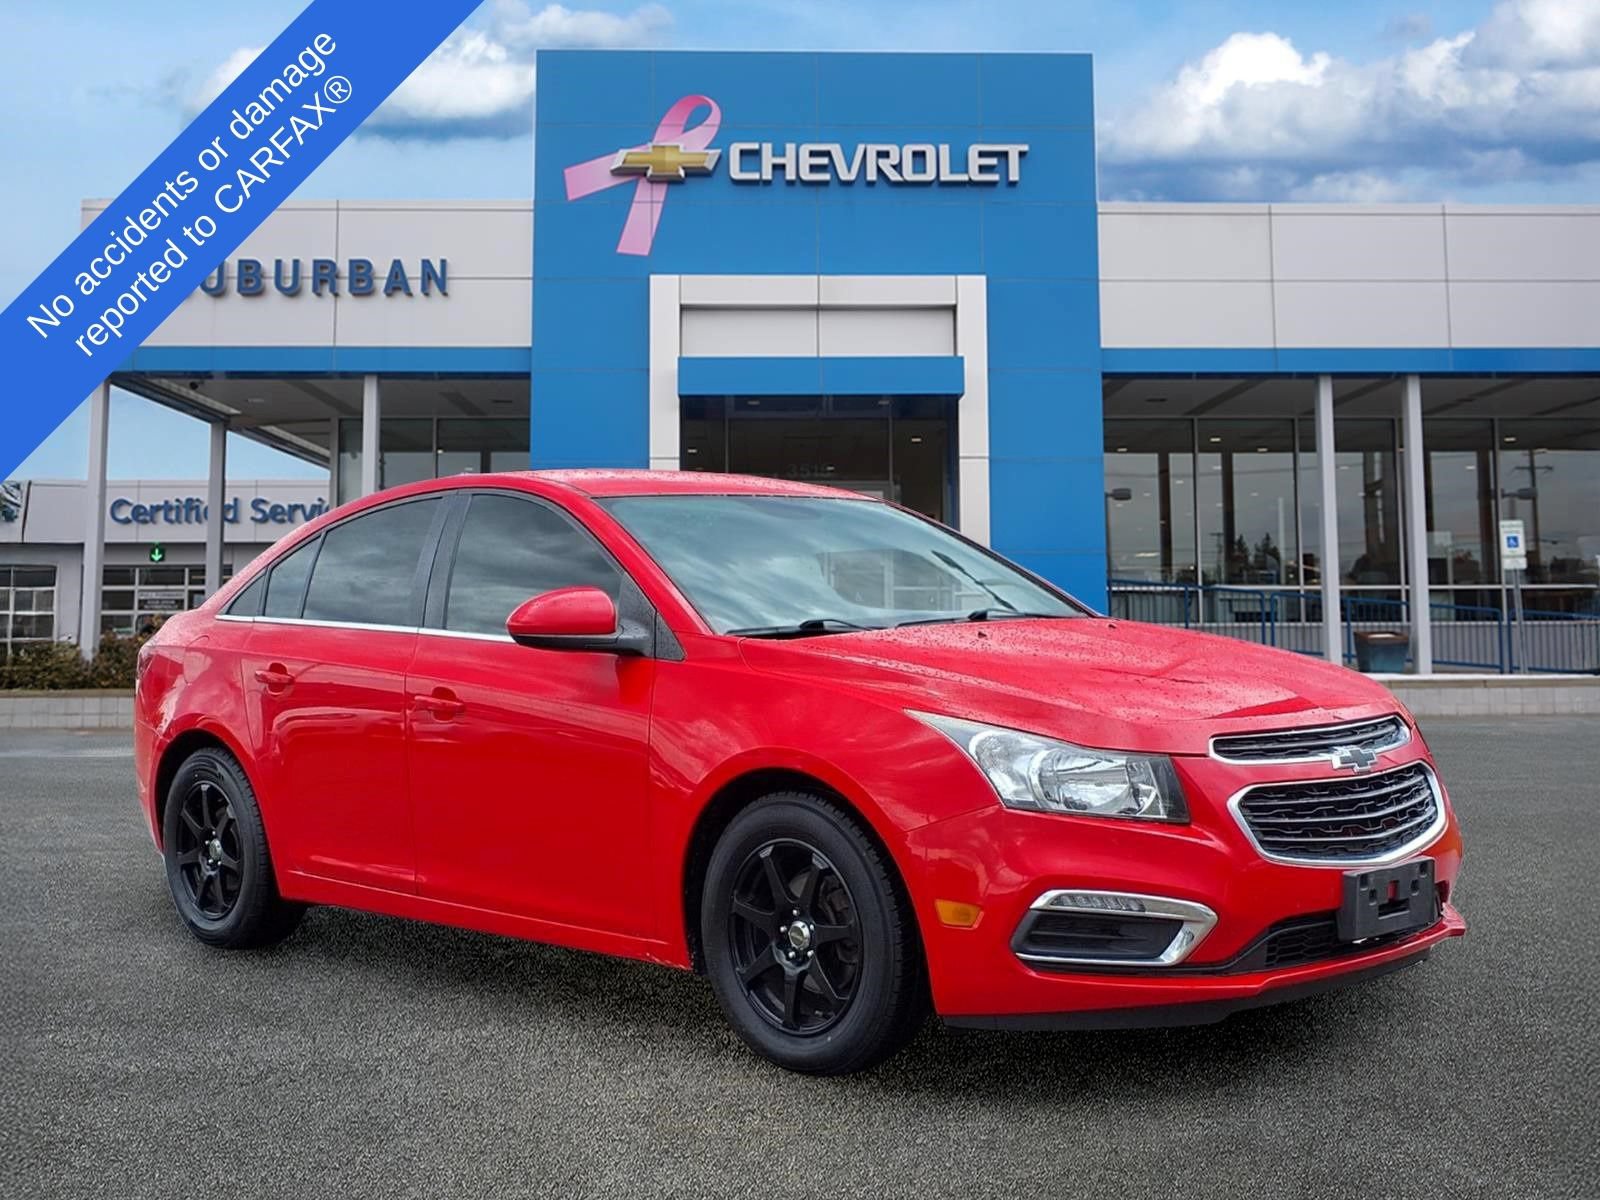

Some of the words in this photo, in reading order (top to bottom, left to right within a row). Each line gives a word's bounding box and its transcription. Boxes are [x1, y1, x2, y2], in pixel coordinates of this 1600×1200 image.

[728, 141, 1029, 184] CHEVROLET
[200, 258, 449, 297] UBURBAN
[250, 497, 330, 524] Servi
